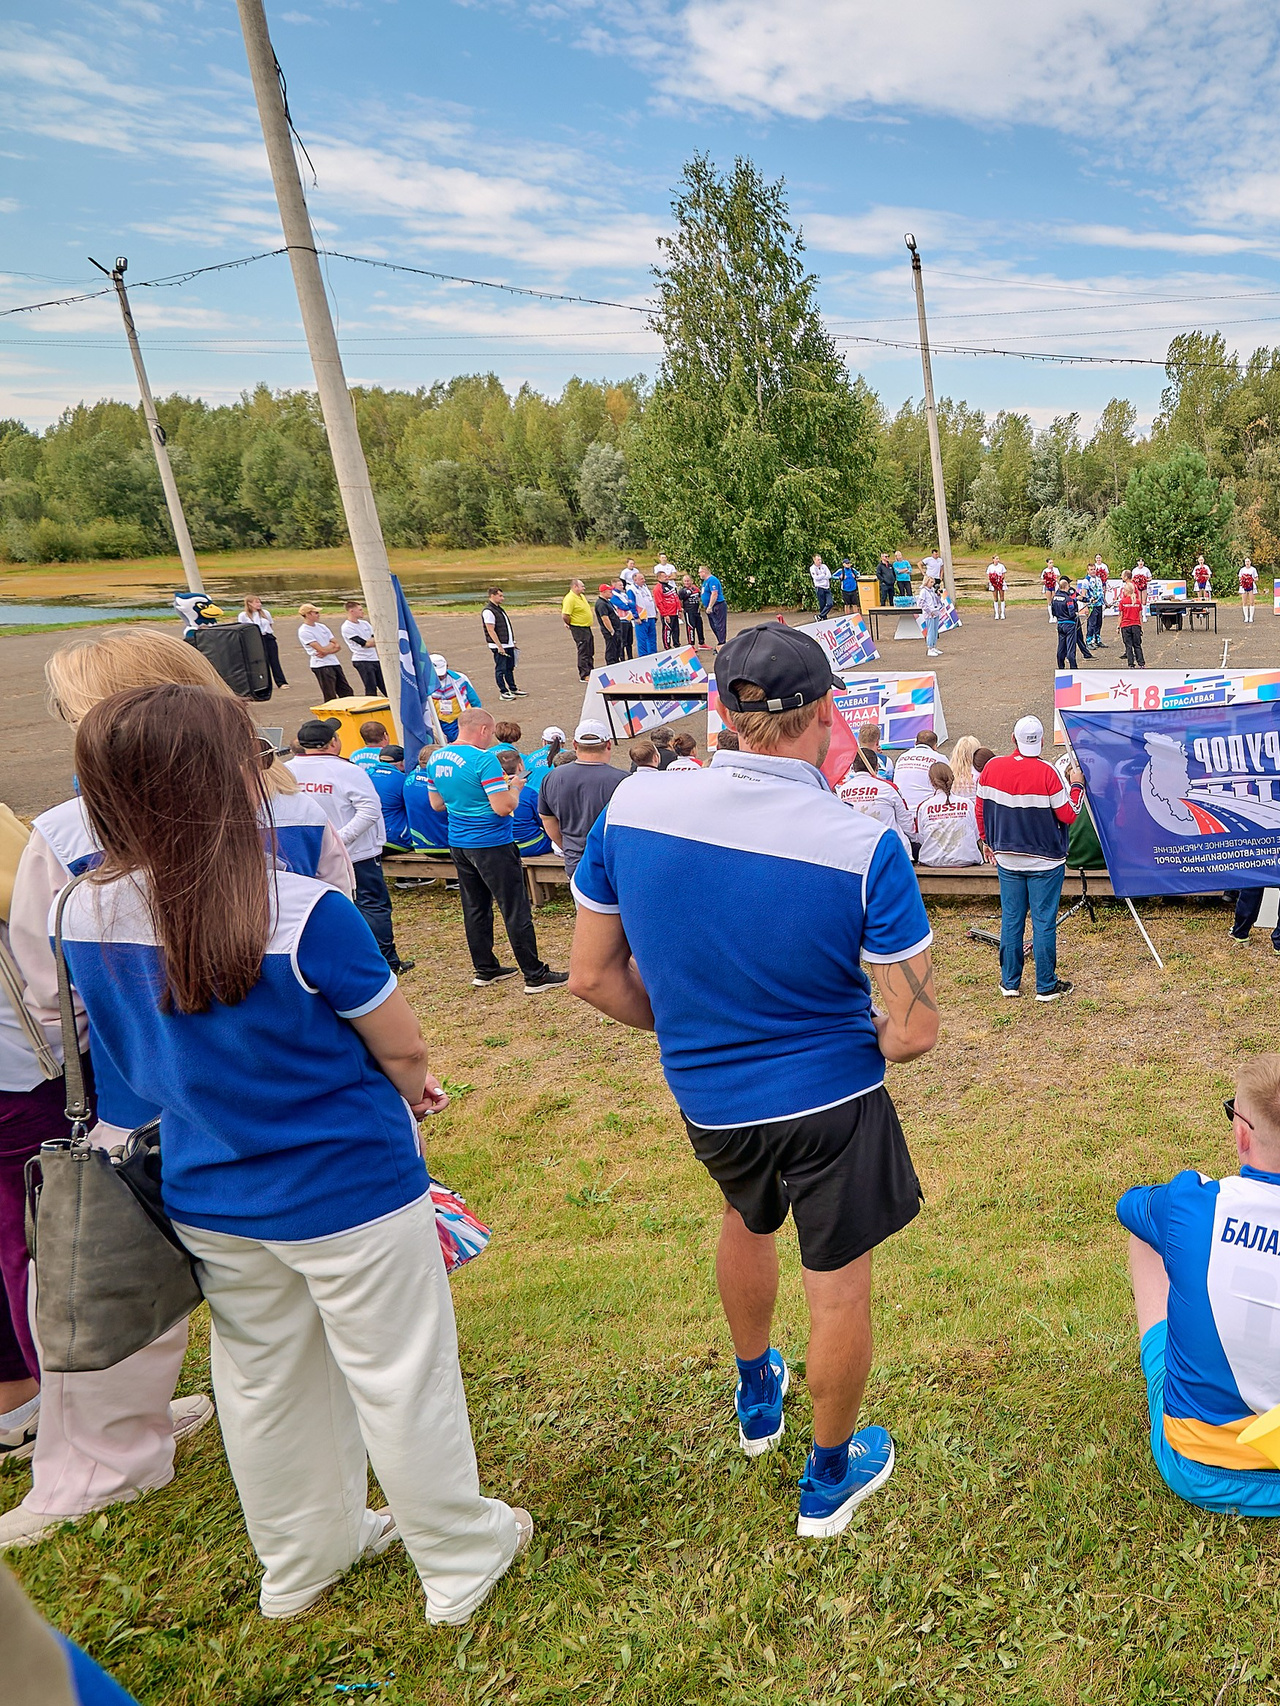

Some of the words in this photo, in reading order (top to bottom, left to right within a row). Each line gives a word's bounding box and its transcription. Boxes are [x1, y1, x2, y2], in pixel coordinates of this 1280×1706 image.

[823, 629, 838, 651] 18
[1130, 685, 1161, 710] 18
[1163, 693, 1215, 708] ОТРАСЛЕВАЯ
[435, 765, 454, 778] ДРСУ
[840, 786, 878, 799] RUSSIA
[927, 802, 968, 815] RUSSIA
